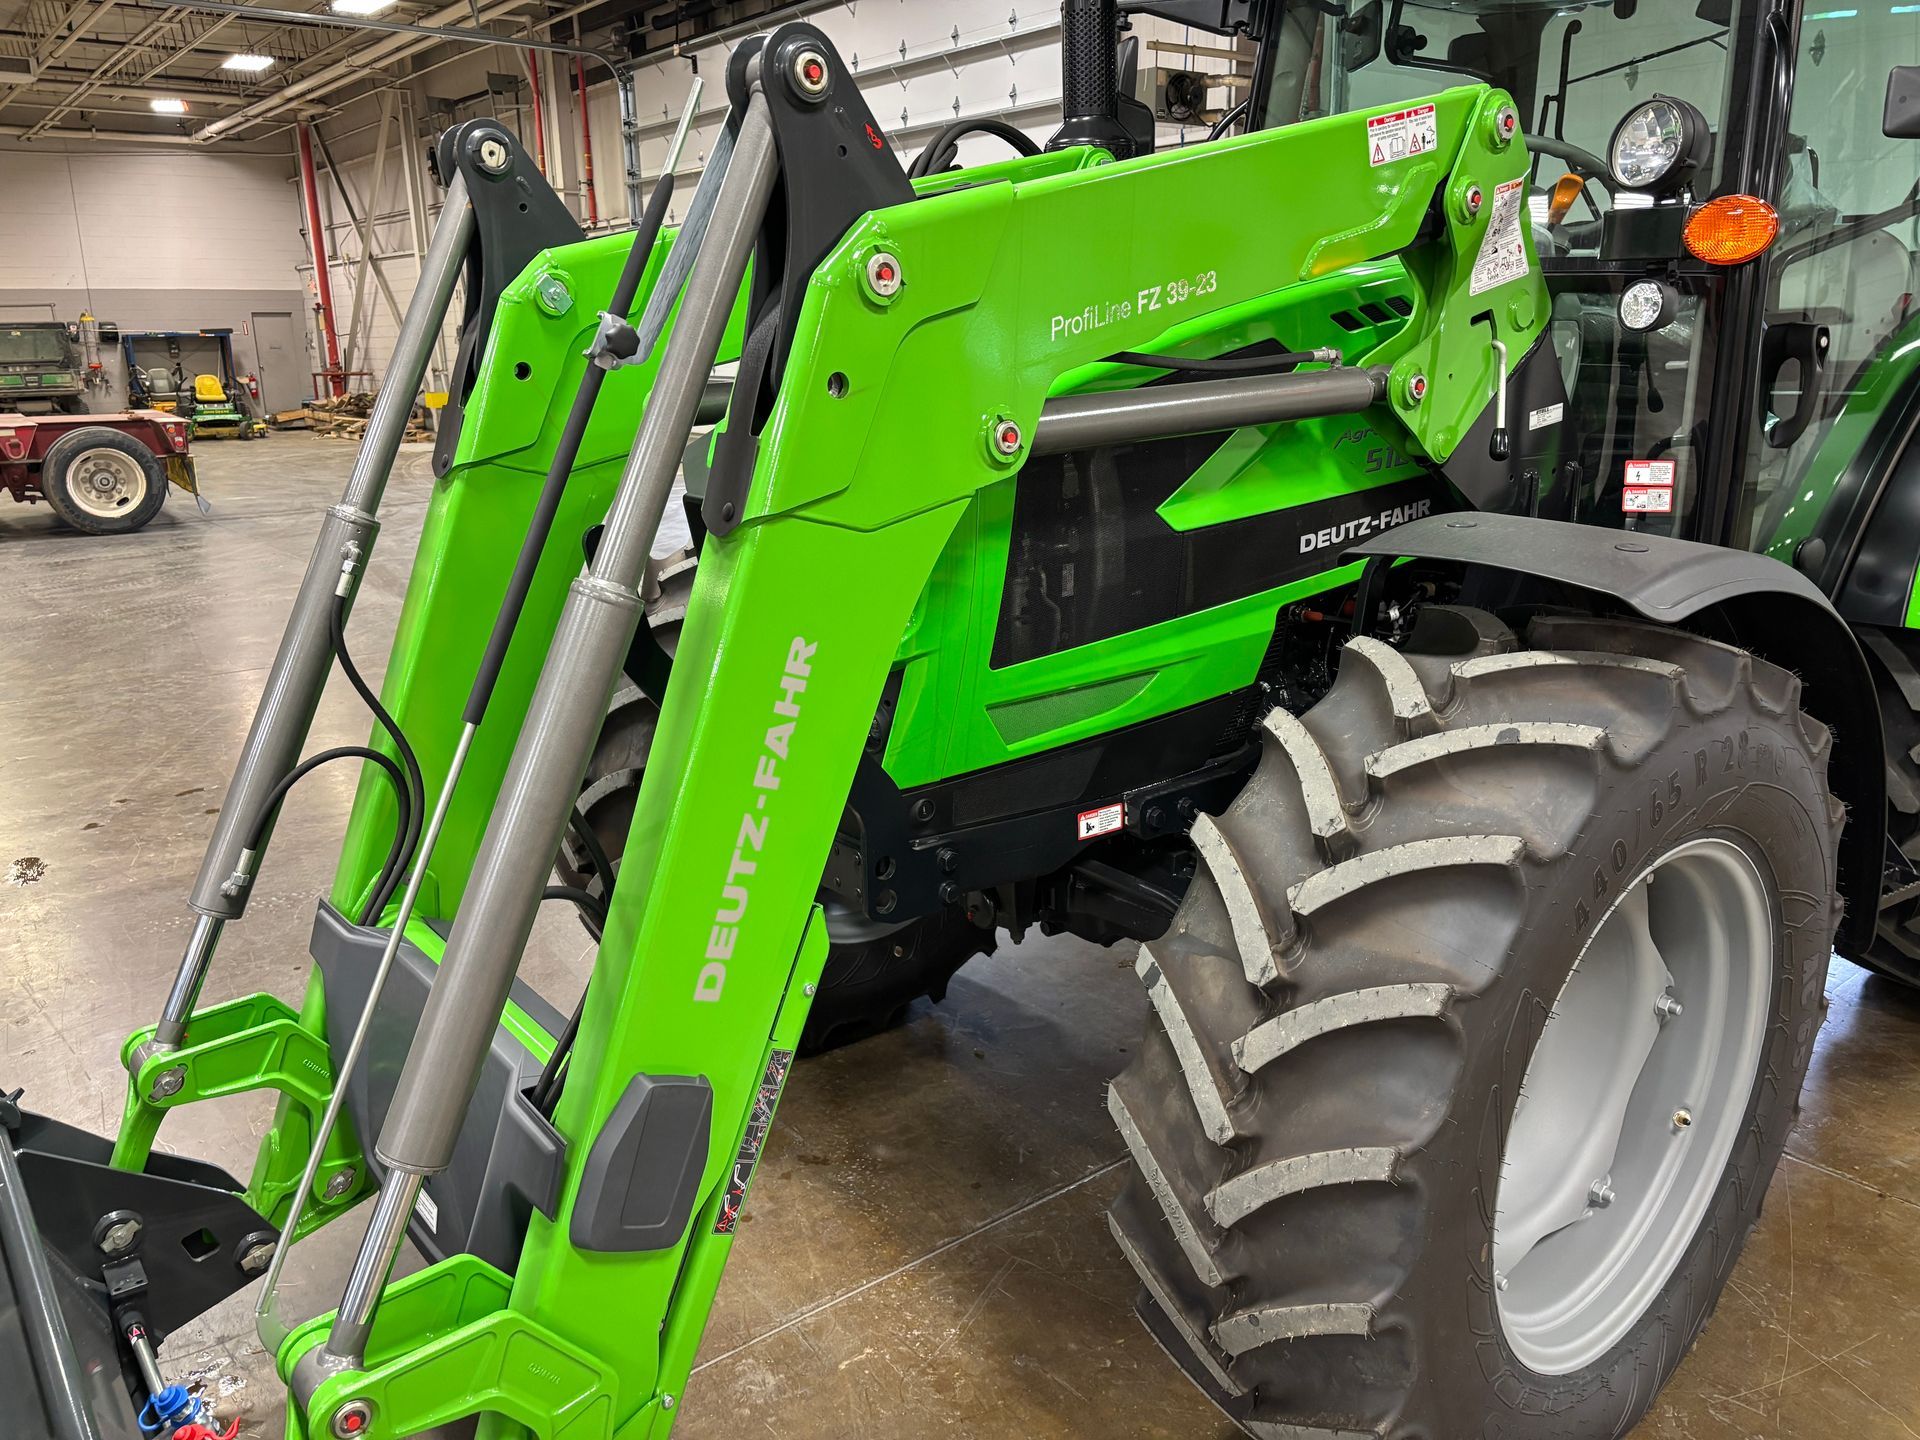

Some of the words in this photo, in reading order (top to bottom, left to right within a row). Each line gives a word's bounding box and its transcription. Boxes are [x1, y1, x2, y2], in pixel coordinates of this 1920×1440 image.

[1051, 301, 1132, 342] ProfiLine
[1137, 286, 1162, 314] FZ
[1167, 270, 1217, 305] 39-23
[1300, 499, 1431, 554] DEUTZ-FAHR
[693, 636, 818, 1002] DEUTZ-FAHR
